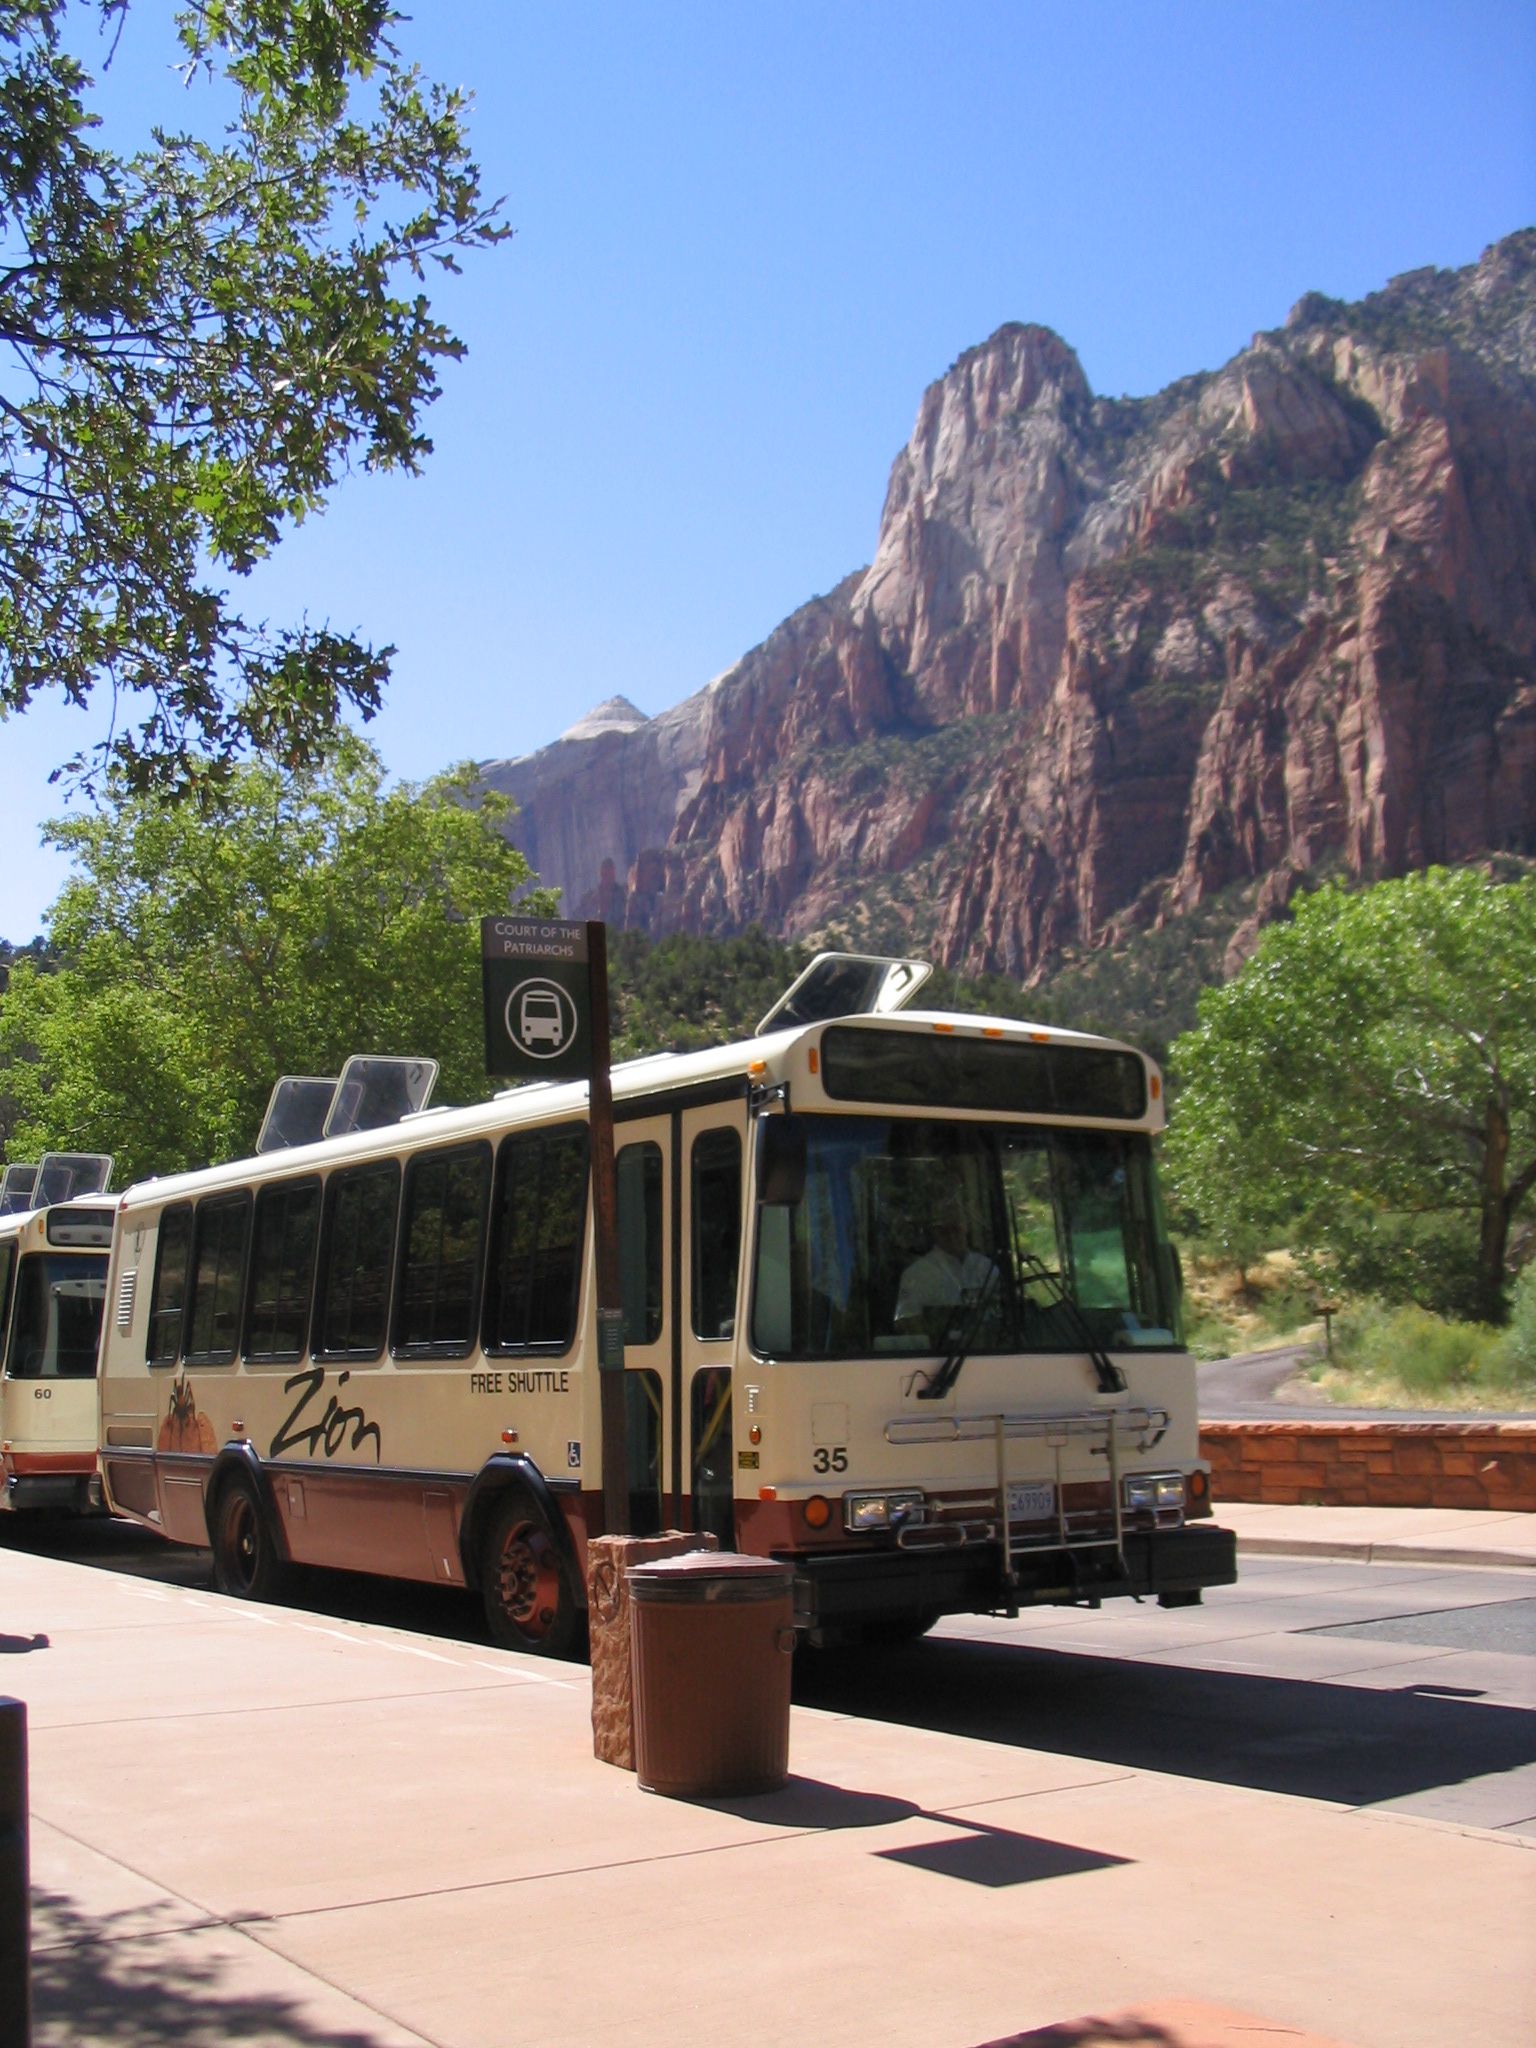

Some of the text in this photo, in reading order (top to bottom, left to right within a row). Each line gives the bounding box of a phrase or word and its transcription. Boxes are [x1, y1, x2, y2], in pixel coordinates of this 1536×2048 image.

[540, 926, 557, 938] OF
[560, 928, 581, 940] THE
[503, 940, 575, 957] PATRIARCHS
[470, 1371, 569, 1393] FREE SHUTTLE
[34, 1388, 52, 1400] 60
[269, 1366, 381, 1464] Zion
[813, 1447, 849, 1474] 35
